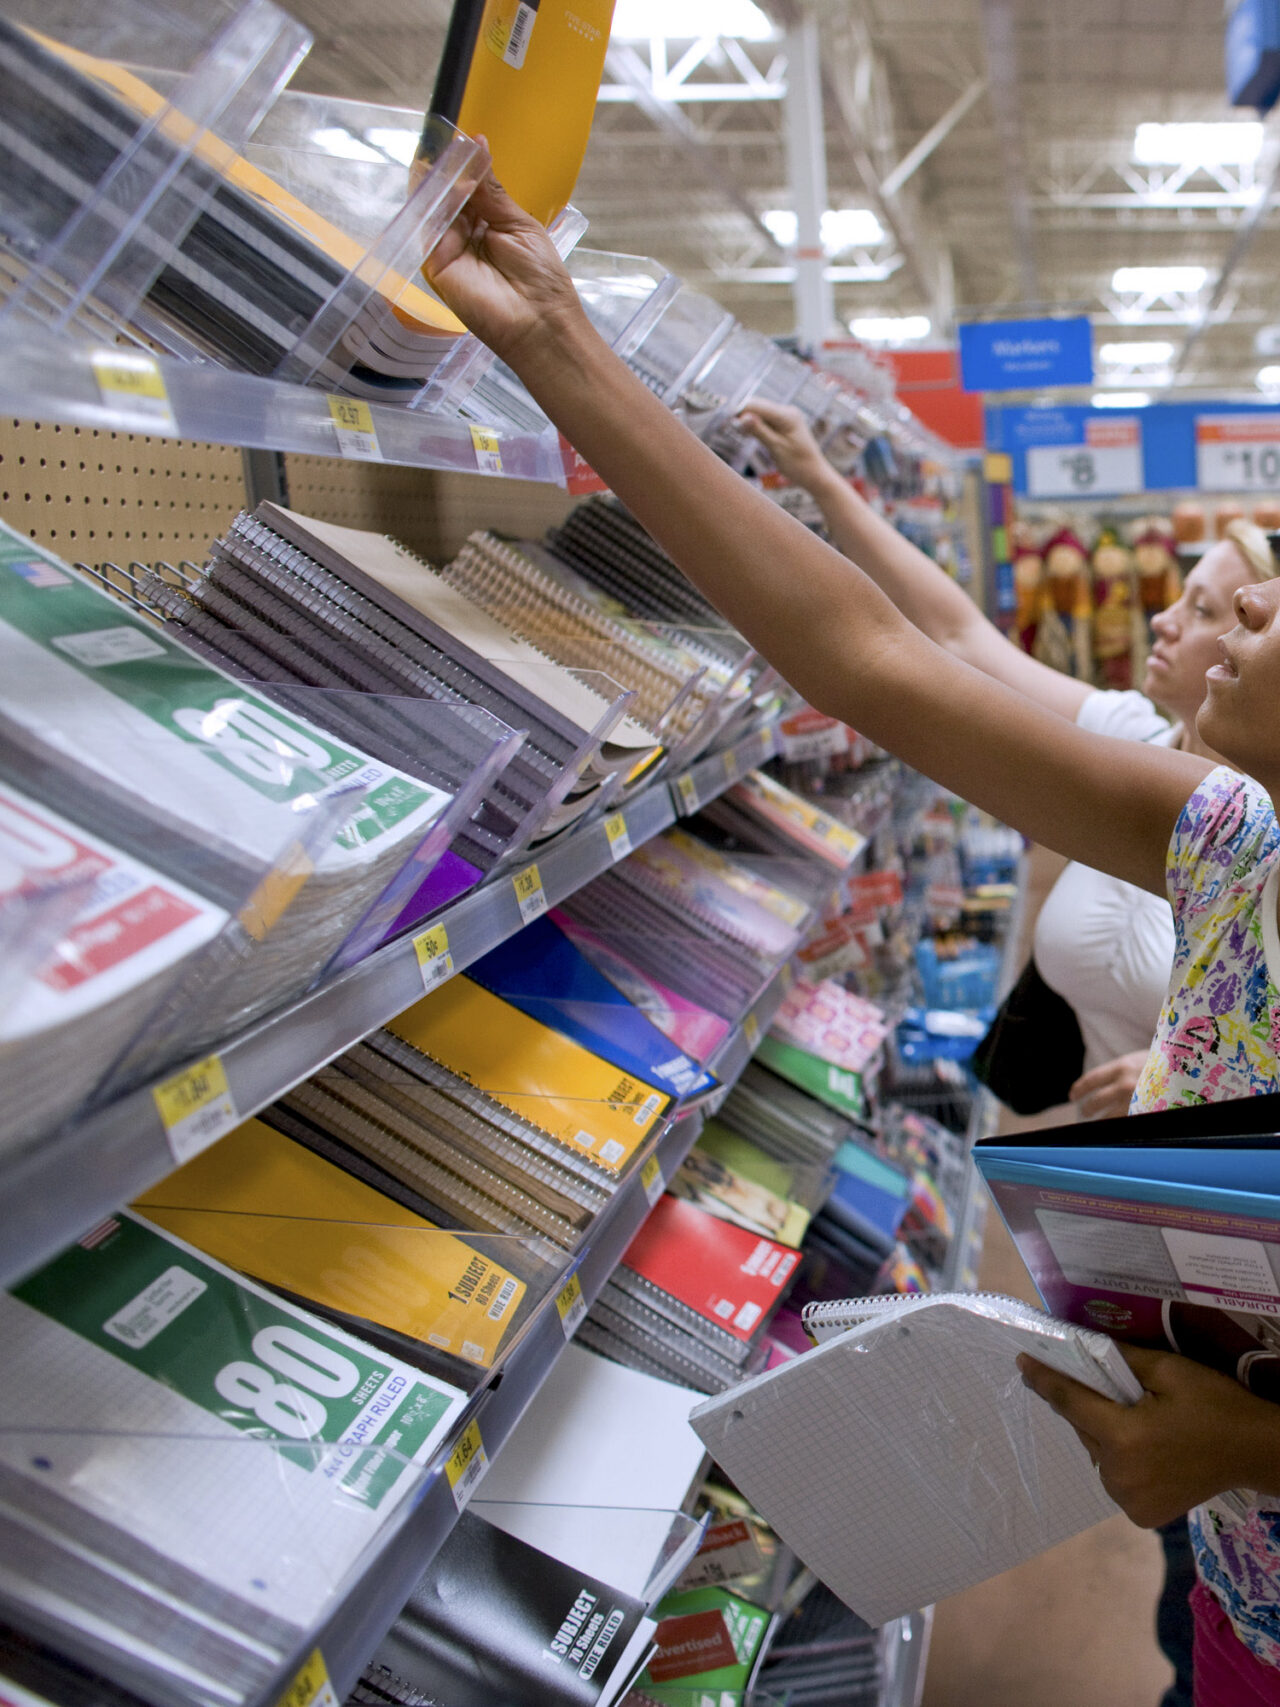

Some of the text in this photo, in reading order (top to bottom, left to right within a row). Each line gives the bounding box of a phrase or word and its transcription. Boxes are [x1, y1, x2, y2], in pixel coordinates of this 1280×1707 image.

[455, 1256, 489, 1299] SUBJECT
[1092, 1277, 1129, 1289] DUTY
[1133, 1283, 1181, 1297] HEAVY
[1213, 1296, 1278, 1312] DURABLE
[214, 1325, 360, 1440] 80
[351, 1369, 386, 1406] SHEETS
[370, 1375, 408, 1420] RULED
[542, 1588, 597, 1665] 1 SUBJECT
[568, 1612, 605, 1663] 70 Sheets
[581, 1615, 621, 1676] WIDE RULED
[655, 1631, 723, 1660] dvertised
